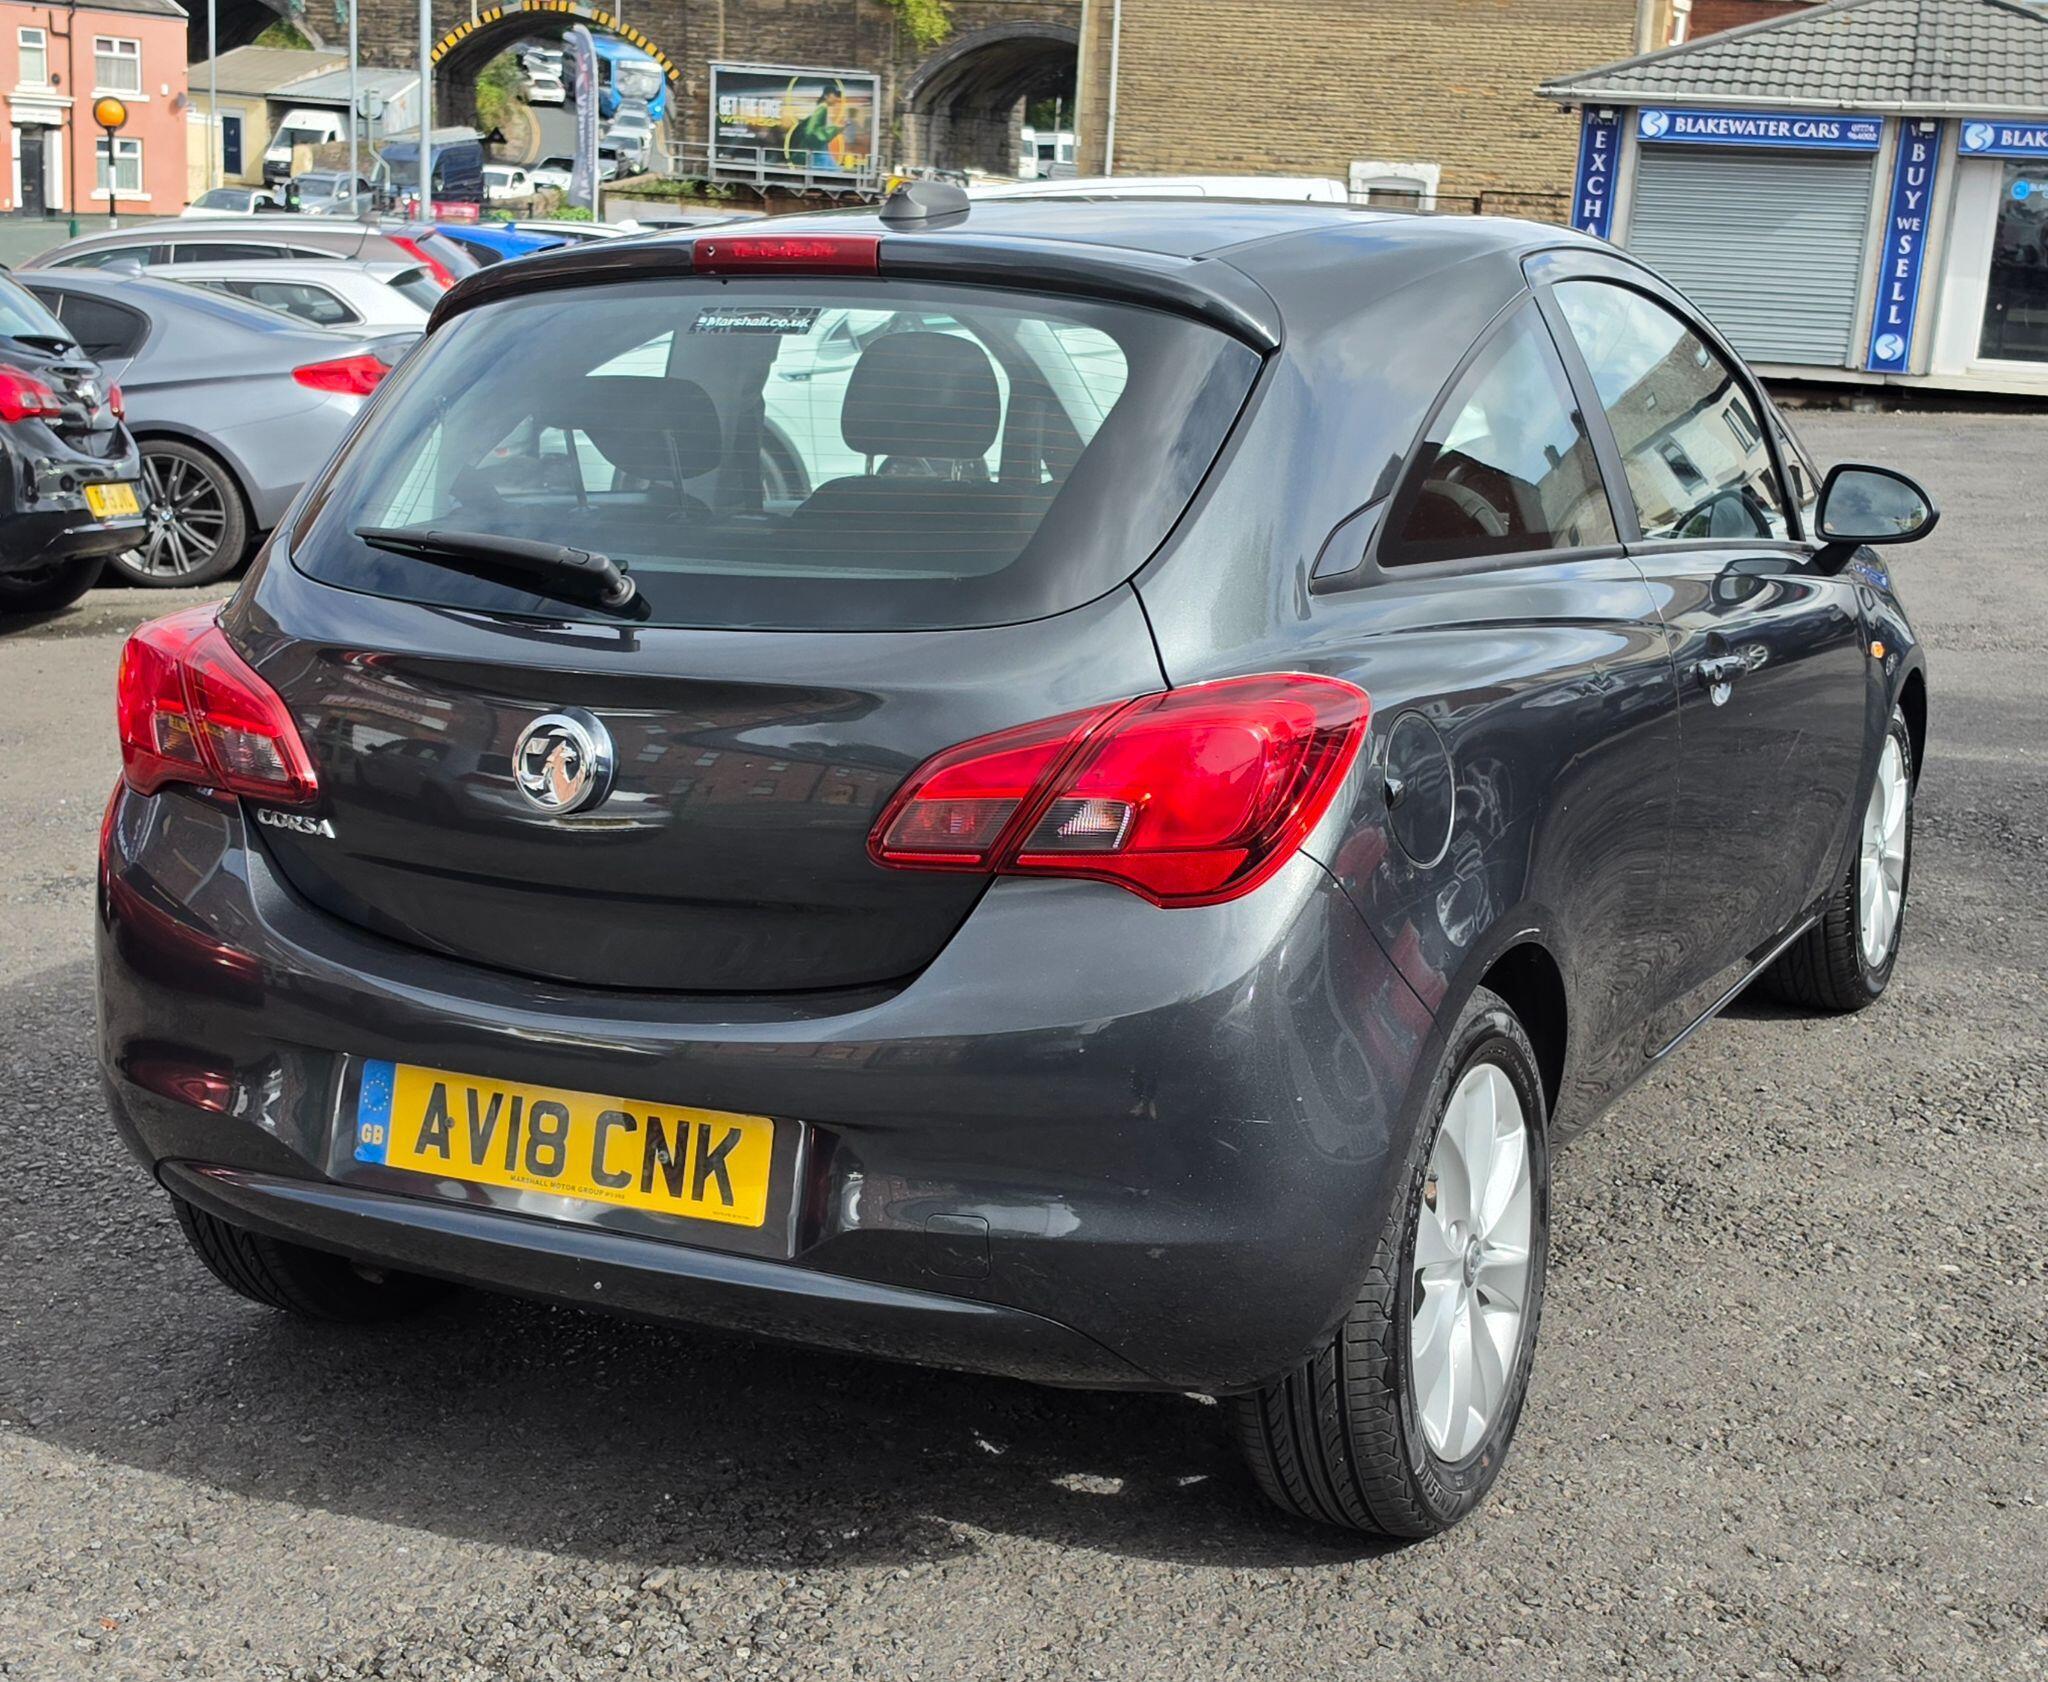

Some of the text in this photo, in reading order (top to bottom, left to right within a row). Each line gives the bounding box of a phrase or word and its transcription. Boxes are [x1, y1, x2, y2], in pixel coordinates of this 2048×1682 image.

[1674, 116, 1840, 139] BLAKEWATER CARS
[1905, 143, 1926, 209] BUY
[1897, 216, 1921, 231] WE
[1888, 234, 1912, 325] SELL
[257, 808, 336, 839] CORSA
[362, 1123, 384, 1145] GB
[413, 1082, 743, 1207] AV18 CNK
[510, 1174, 548, 1187] MARSHALL
[550, 1182, 576, 1193] MOTOR
[577, 1186, 604, 1196] GROUP
